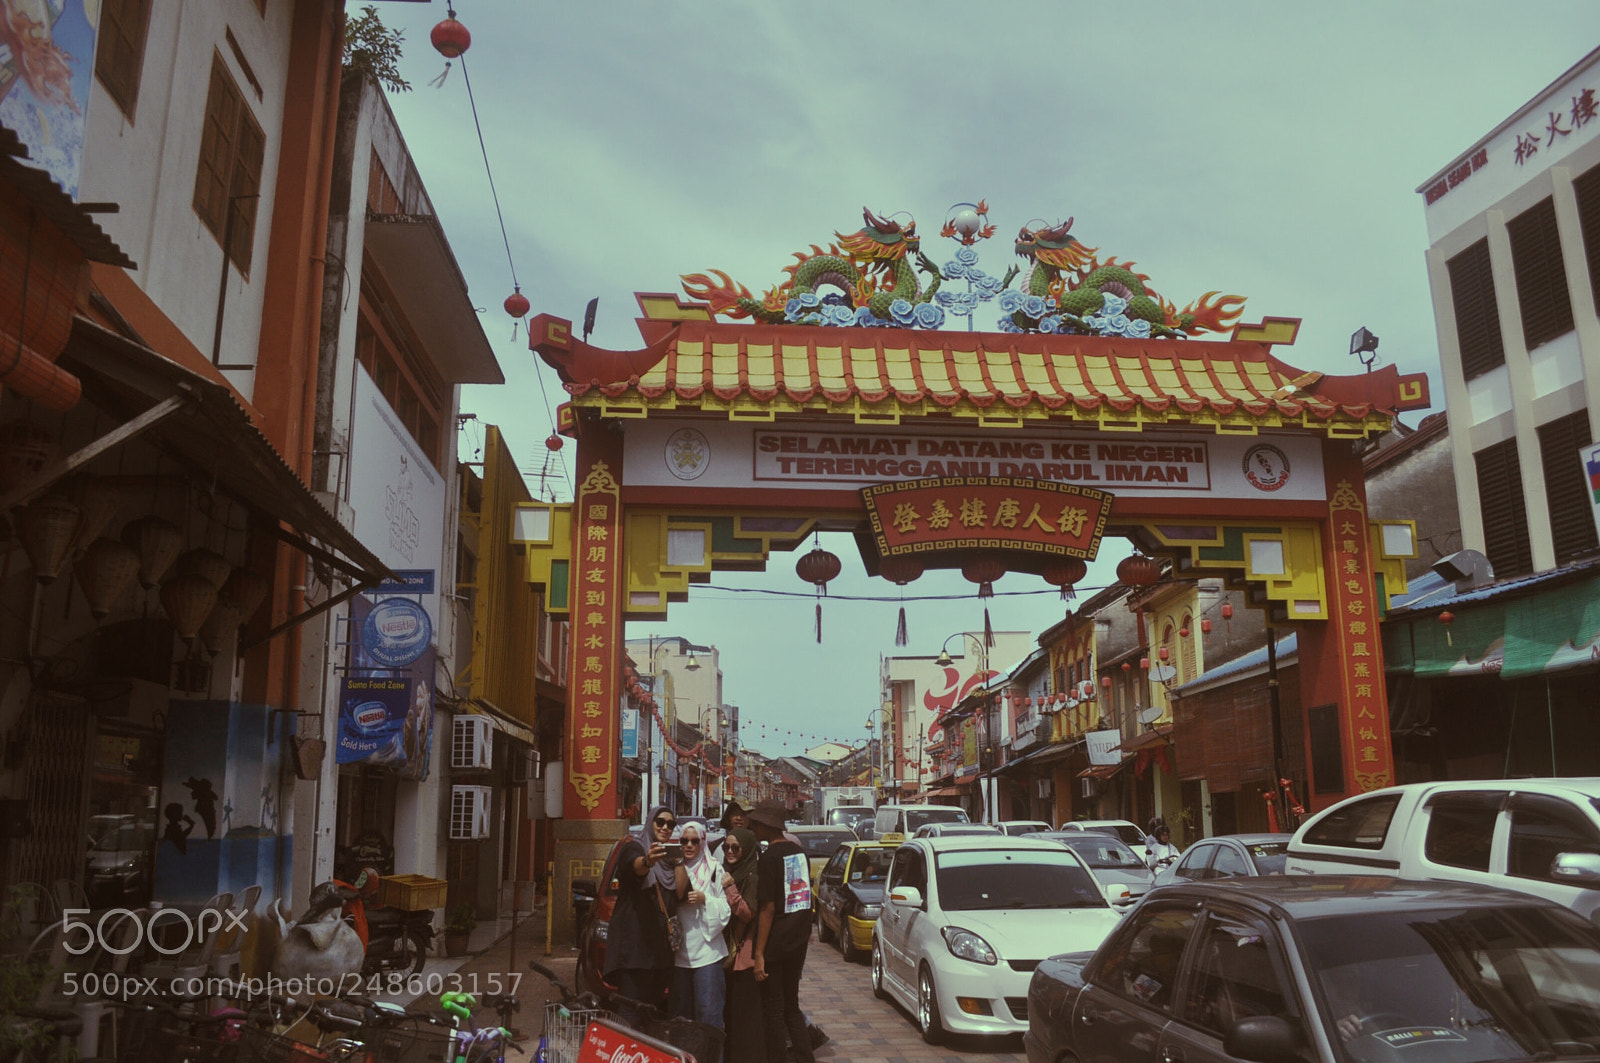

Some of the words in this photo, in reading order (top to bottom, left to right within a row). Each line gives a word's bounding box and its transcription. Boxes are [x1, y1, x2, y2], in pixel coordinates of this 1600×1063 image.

[758, 435, 912, 457] SELAMAT
[918, 438, 1045, 460] DATANG
[1052, 443, 1094, 462] KE
[1096, 444, 1205, 464] NEGERI
[776, 456, 991, 479] TERENGGANU
[998, 461, 1099, 482] DARUL
[1105, 463, 1188, 483] IMAN
[347, 680, 368, 690] Sumo
[369, 680, 386, 689] Food
[387, 680, 405, 690] Zone
[340, 737, 357, 750] Sold
[358, 741, 377, 751] Here
